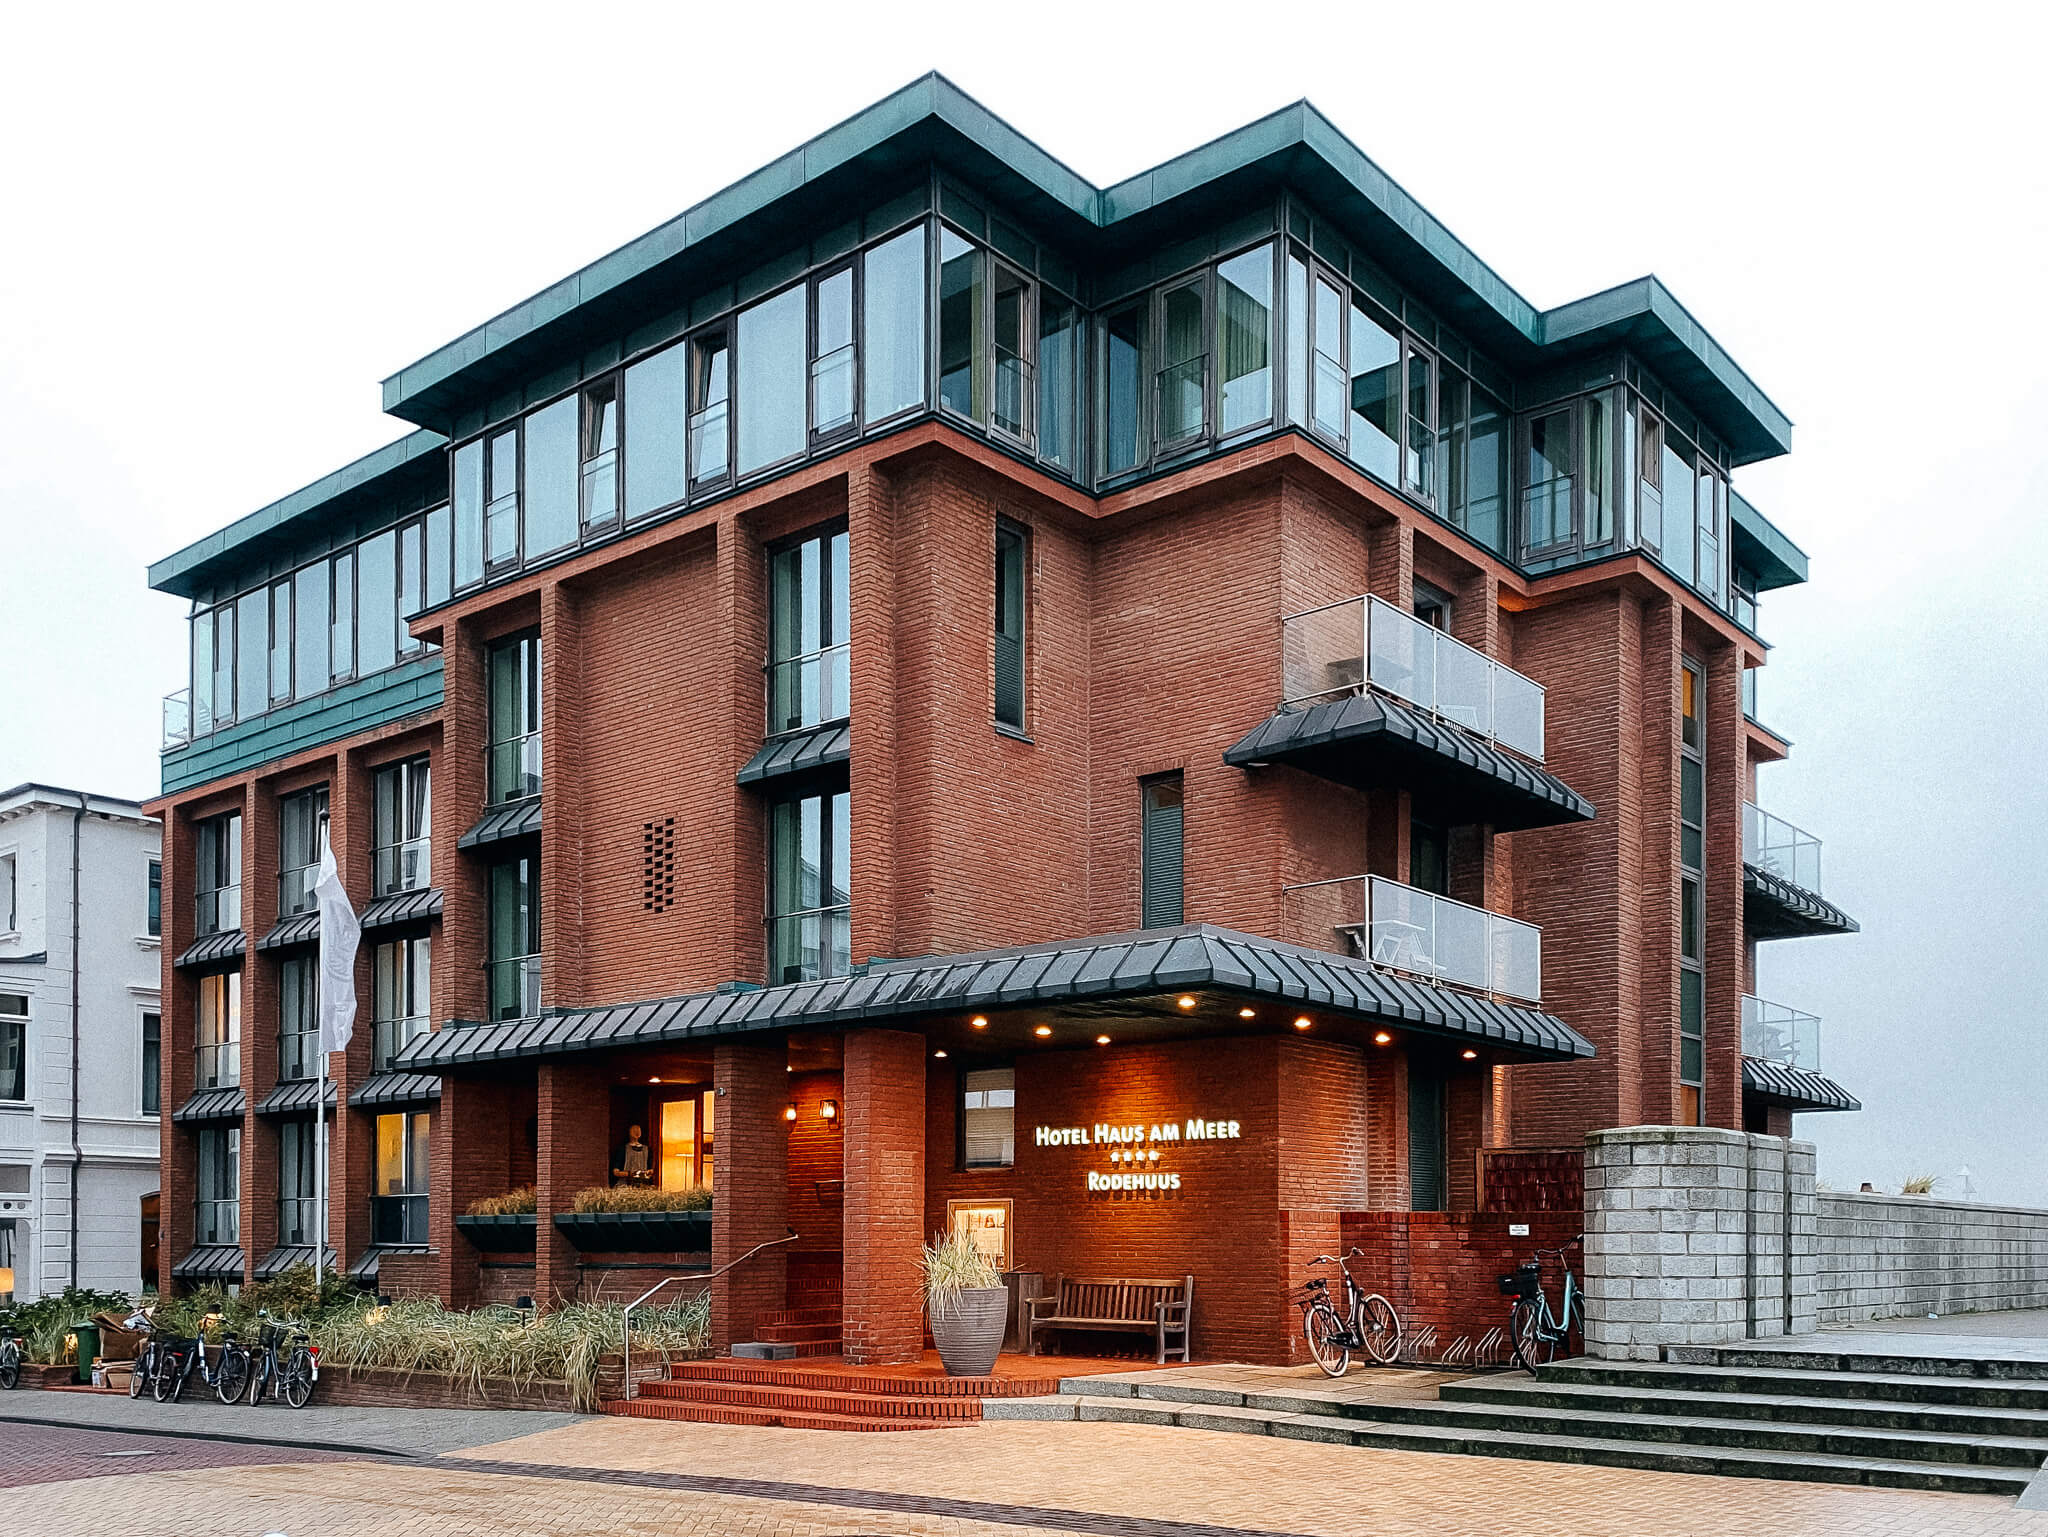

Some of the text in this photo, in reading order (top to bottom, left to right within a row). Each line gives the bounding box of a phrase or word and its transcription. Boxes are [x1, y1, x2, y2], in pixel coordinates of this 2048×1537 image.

[1036, 1119, 1241, 1146] HOTEL HAUS AM MEER
[1088, 1171, 1181, 1191] RODEHUUS
